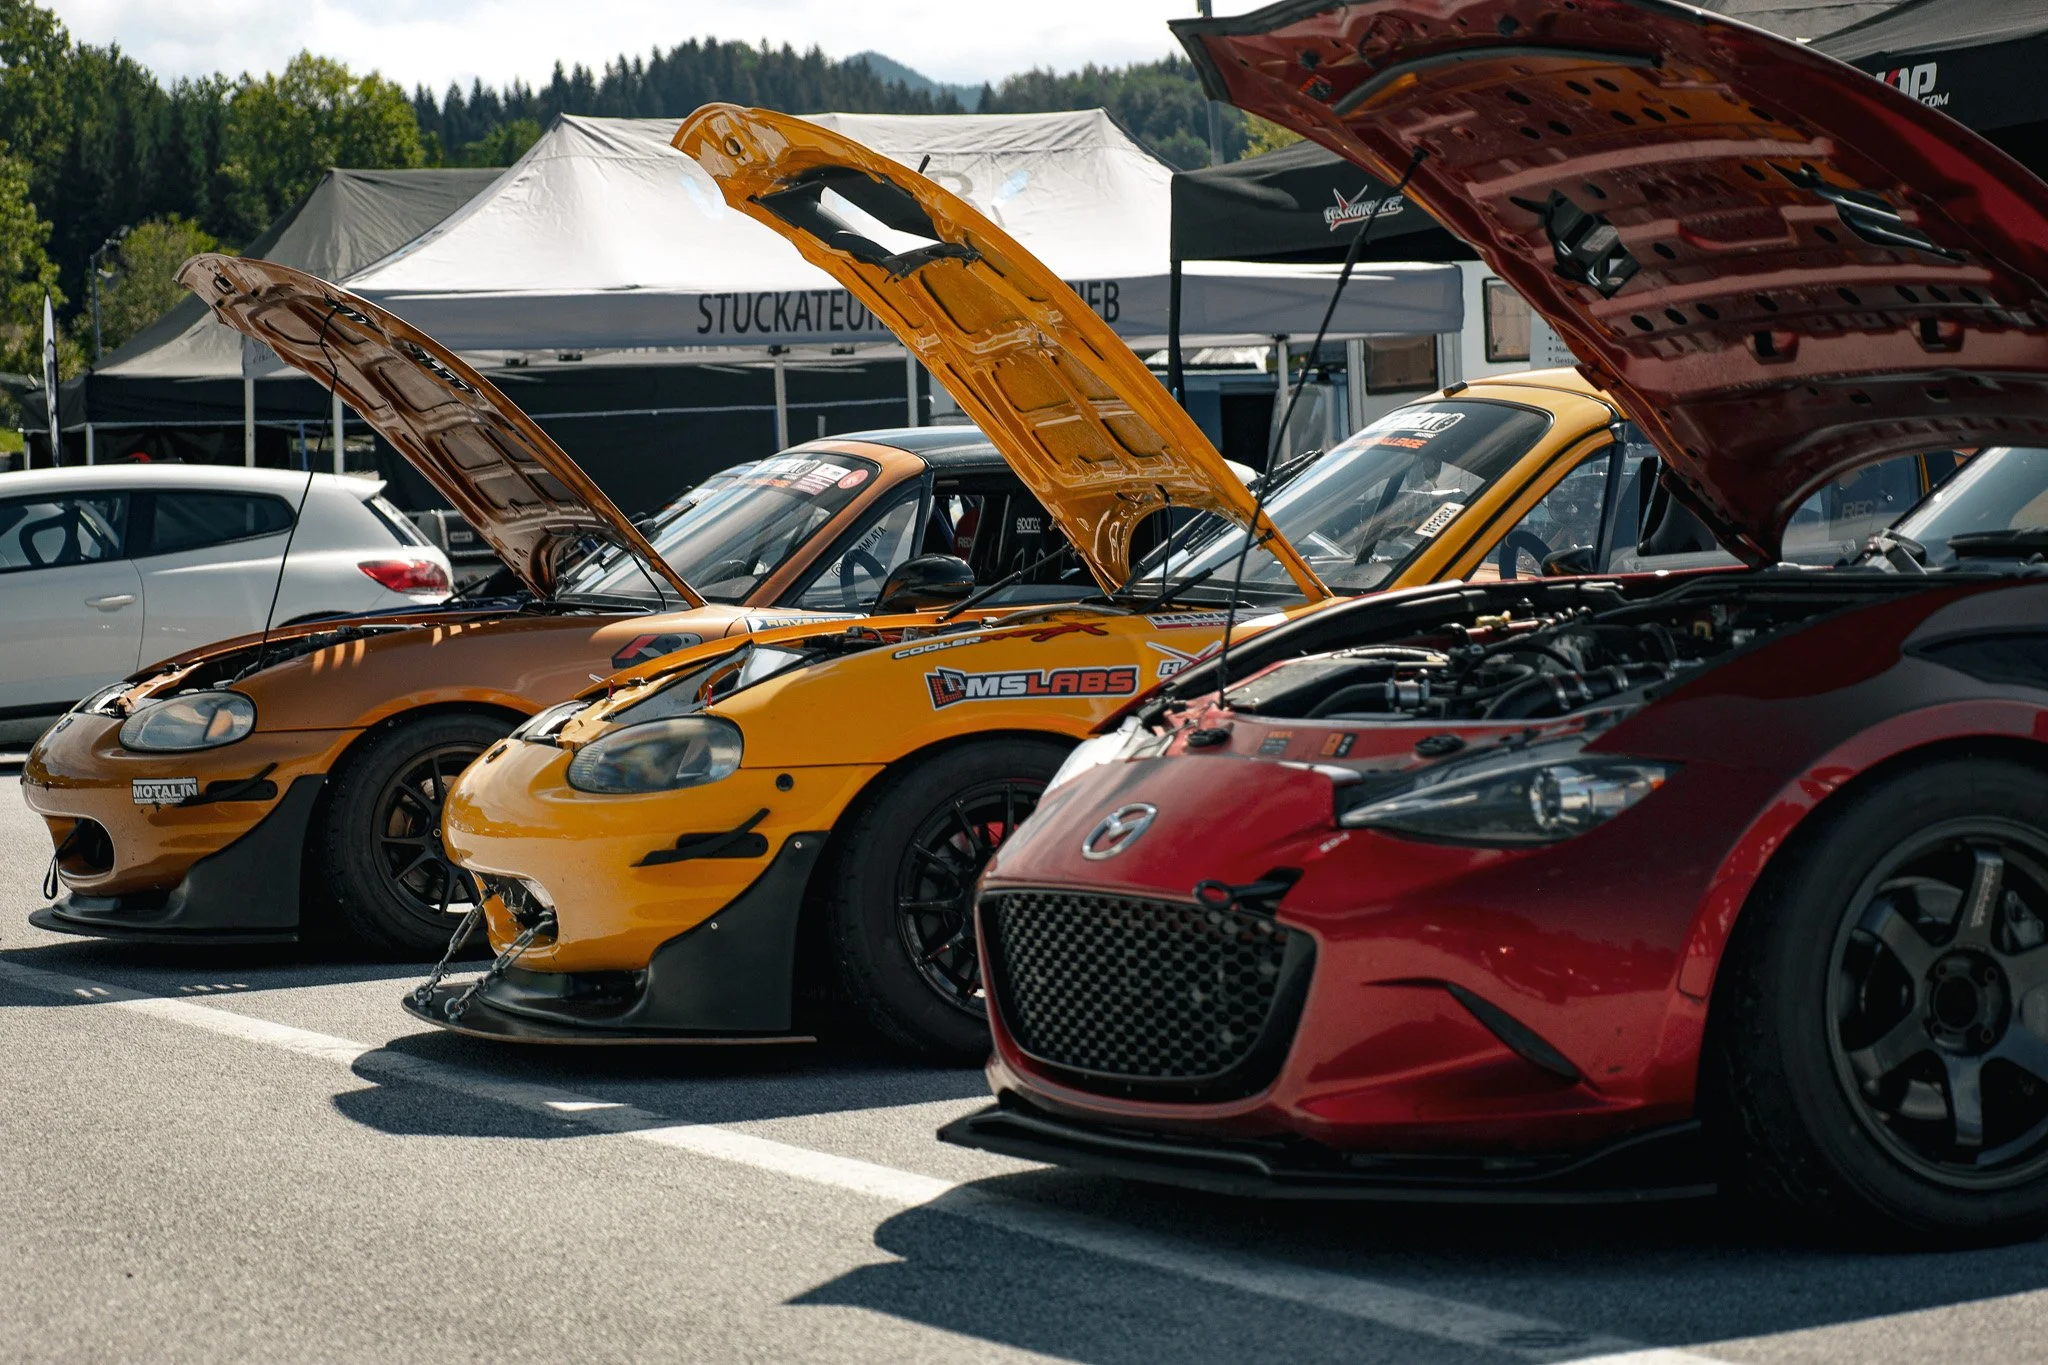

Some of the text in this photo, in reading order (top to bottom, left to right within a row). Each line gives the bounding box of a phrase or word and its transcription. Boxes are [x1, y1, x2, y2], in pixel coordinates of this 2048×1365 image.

[1875, 62, 1938, 100] OP
[1323, 194, 1404, 223] HARDRCE
[132, 783, 198, 799] MOTALIN
